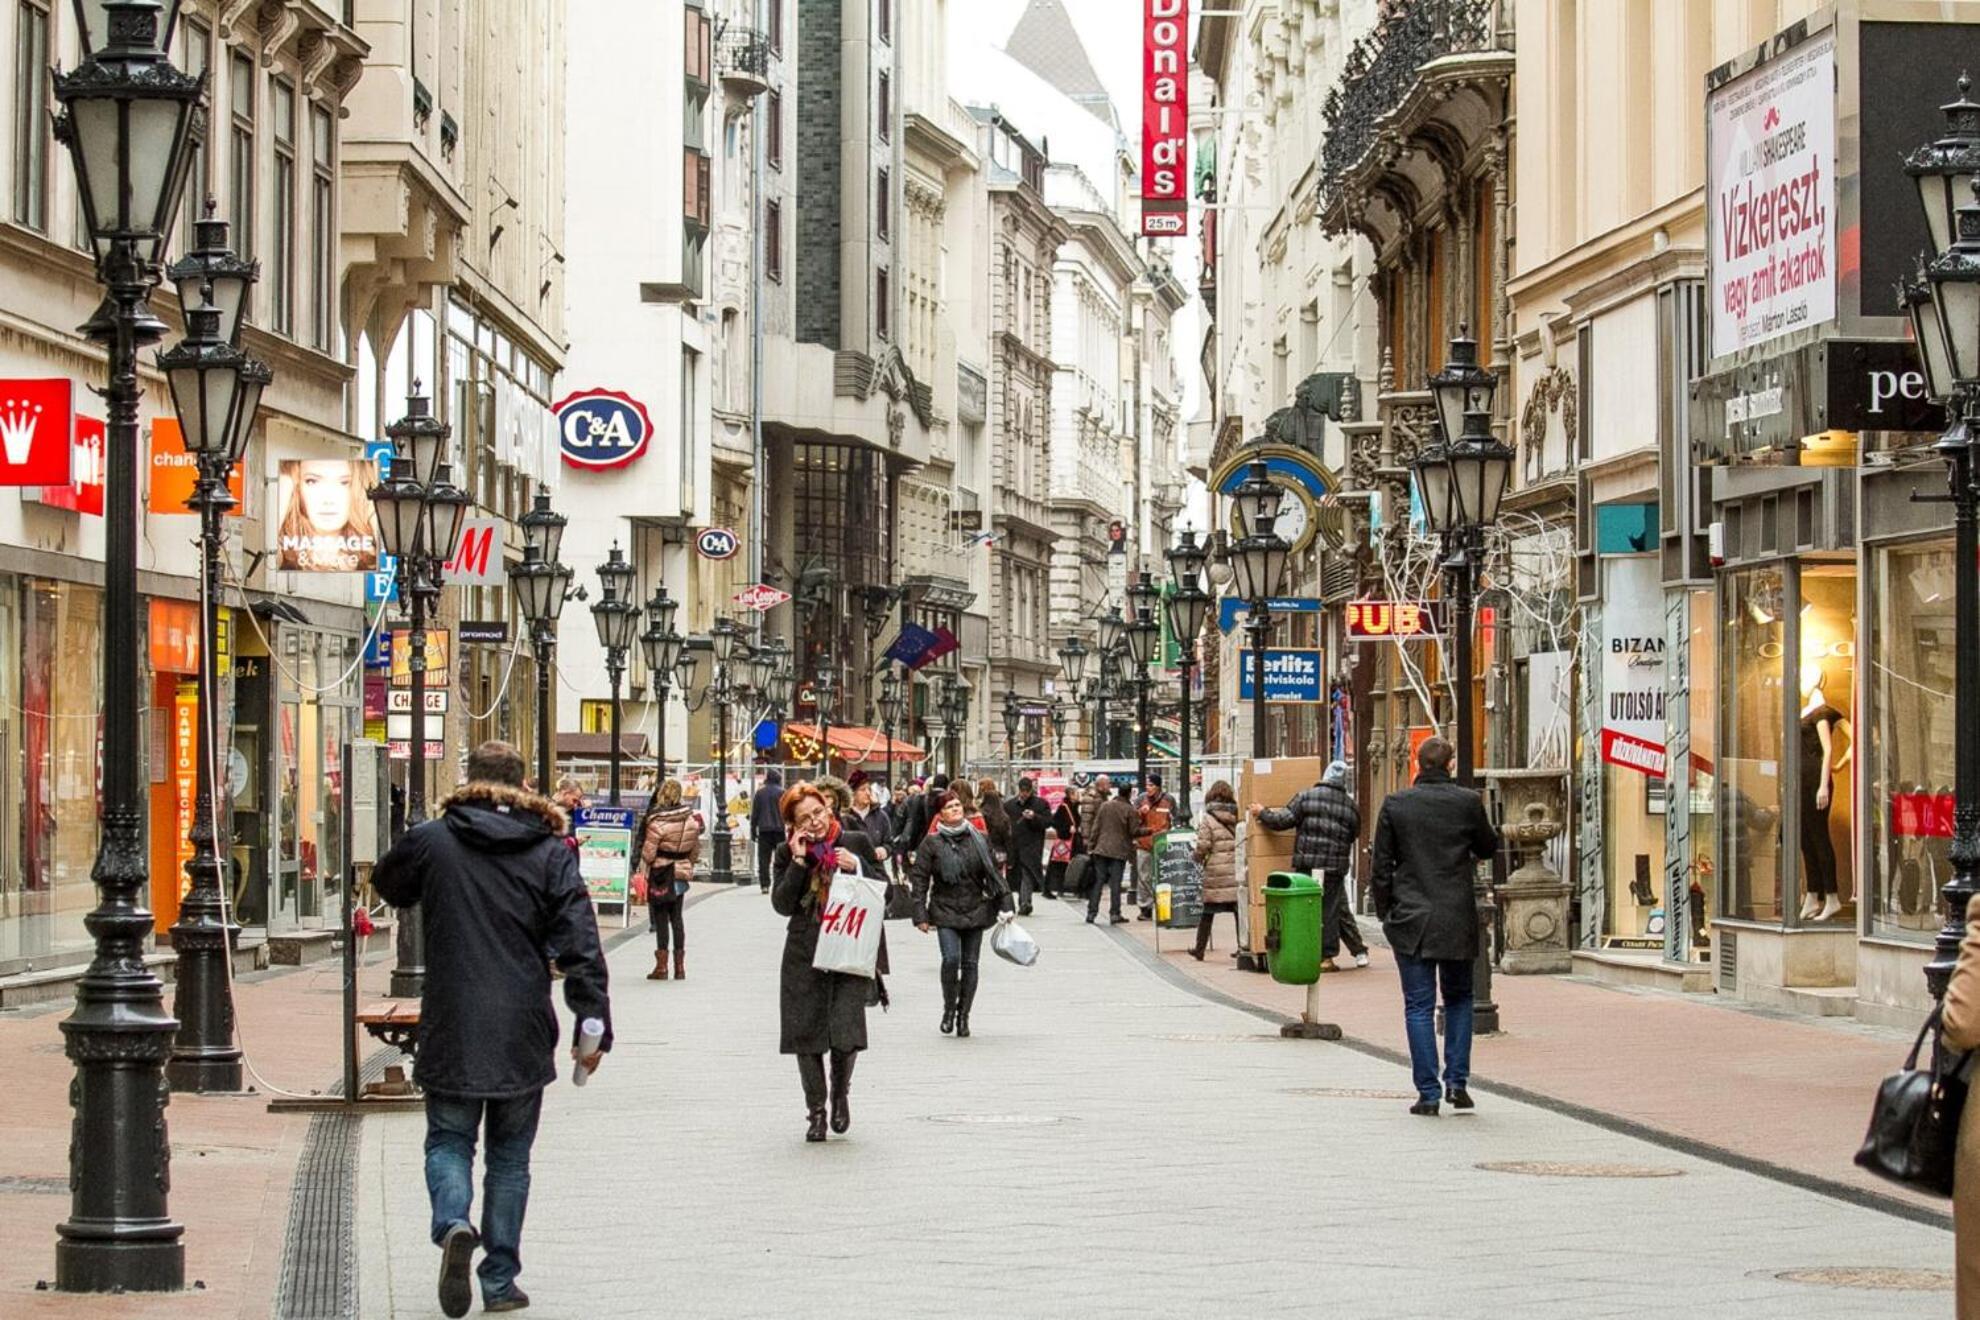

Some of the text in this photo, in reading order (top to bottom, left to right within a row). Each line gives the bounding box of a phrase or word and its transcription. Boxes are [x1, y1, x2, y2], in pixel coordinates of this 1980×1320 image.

[1722, 153, 1825, 262] Vízkereszt,
[1149, 217, 1177, 229] 25 m
[1724, 235, 1825, 320] vagy amit akartok
[1868, 370, 1928, 413] pe
[564, 410, 635, 447] C&A
[153, 452, 198, 467] chan
[1246, 674, 1314, 685] Nelviskola
[394, 694, 441, 707] CHGE
[581, 808, 628, 824] Change
